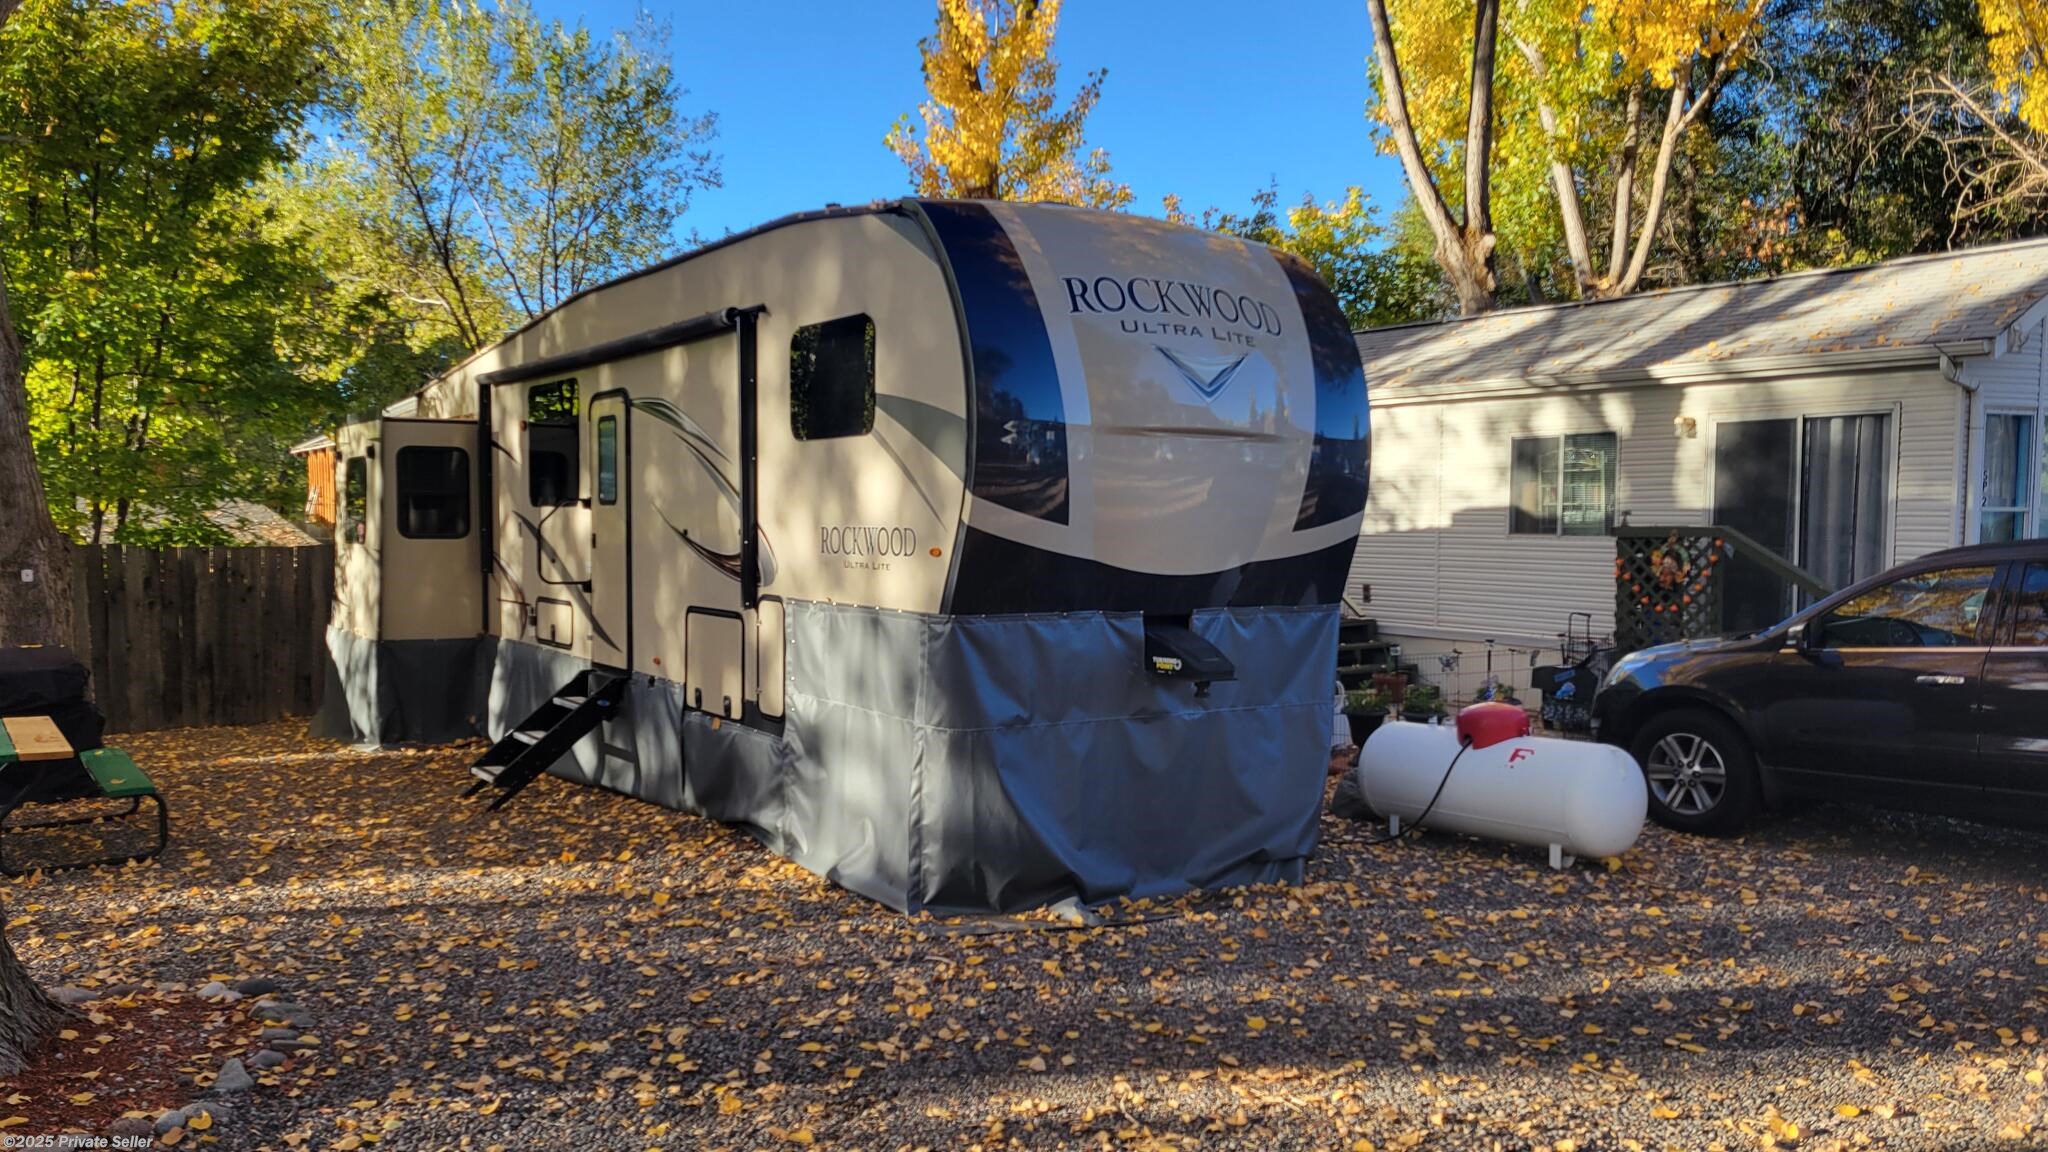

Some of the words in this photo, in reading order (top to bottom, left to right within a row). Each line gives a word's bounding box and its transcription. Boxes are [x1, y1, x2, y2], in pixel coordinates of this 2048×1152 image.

[1062, 276, 1282, 337] ROCKWOOD
[1121, 319, 1203, 338] ULTRA
[1212, 327, 1256, 347] LITE
[820, 526, 917, 557] ROCKWOOD
[844, 561, 869, 570] ULTRA
[871, 562, 891, 571] LITE
